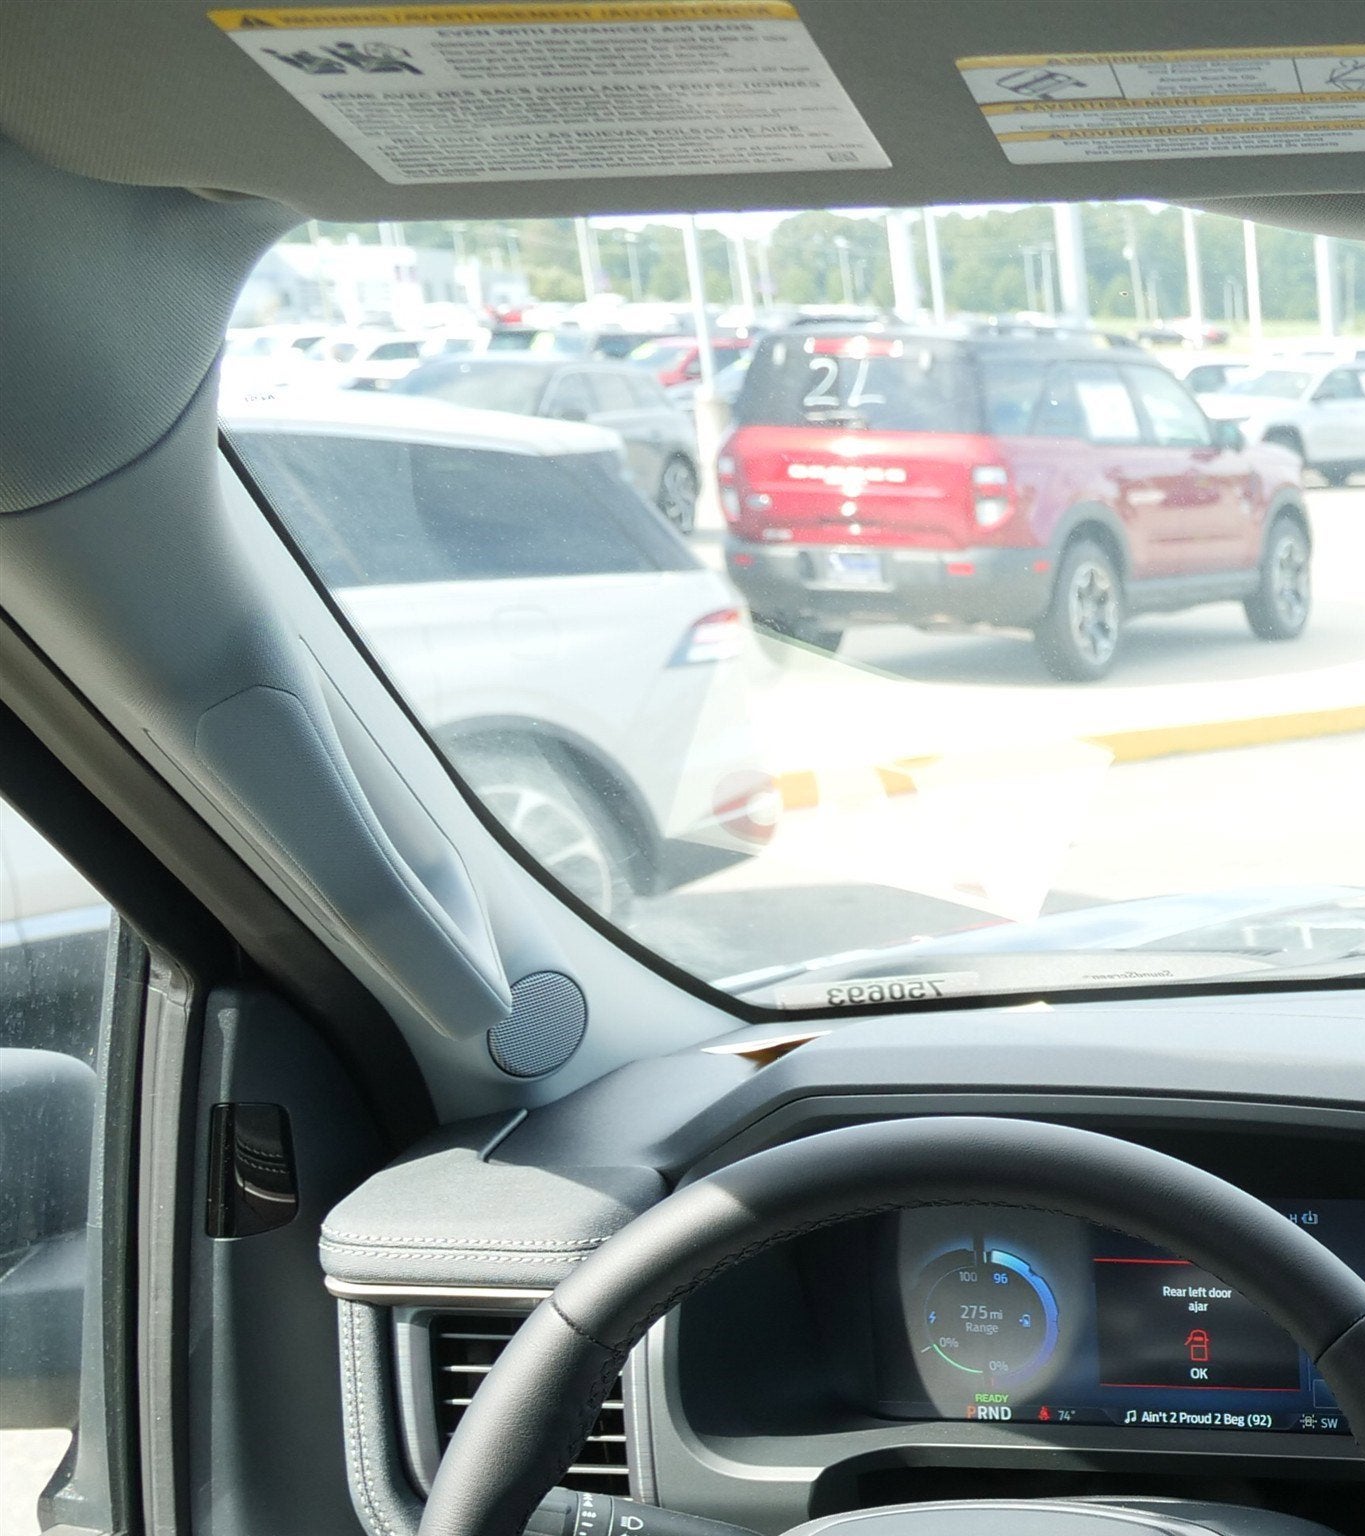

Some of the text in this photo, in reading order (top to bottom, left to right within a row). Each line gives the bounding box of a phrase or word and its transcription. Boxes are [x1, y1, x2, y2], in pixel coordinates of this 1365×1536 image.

[959, 1271, 978, 1282] 100
[993, 1273, 1008, 1284] 96
[1162, 1286, 1232, 1298] Rear left door
[960, 1305, 1003, 1319] 275 mi
[1188, 1301, 1208, 1312] ajar
[965, 1323, 999, 1335] Range
[939, 1337, 959, 1348] 0%
[1190, 1368, 1208, 1380] OK
[974, 1393, 1009, 1403] READY
[1058, 1409, 1076, 1420] 74°
[1141, 1412, 1272, 1428] Ain't 2 Proud 2 Beg (92)
[1320, 1418, 1338, 1429] SW
